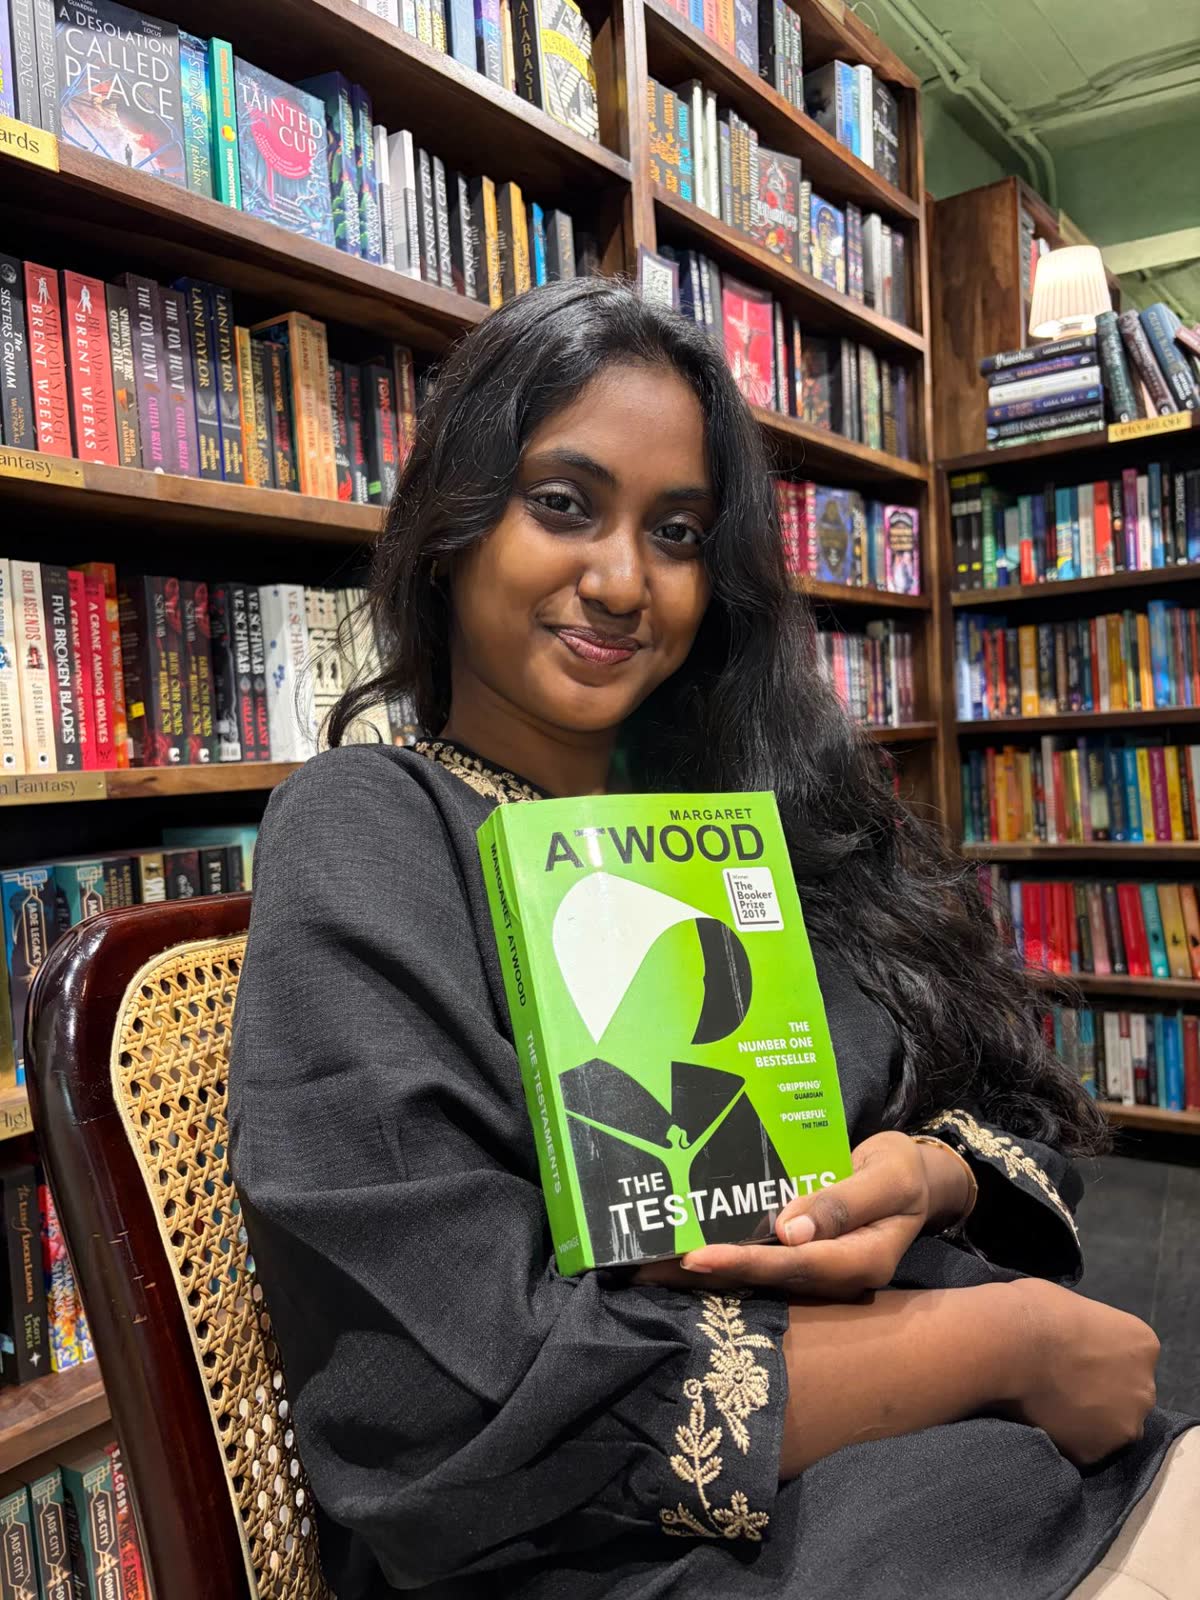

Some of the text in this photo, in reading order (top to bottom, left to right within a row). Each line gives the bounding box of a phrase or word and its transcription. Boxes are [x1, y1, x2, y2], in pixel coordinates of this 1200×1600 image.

[59, 5, 71, 21] A
[75, 10, 173, 57] DESOLATION
[65, 27, 169, 83] CALLED
[143, 27, 162, 38] LOCUS
[518, 1, 535, 104] ATABASI
[65, 54, 174, 121] PEACE
[188, 57, 201, 112] STONE
[192, 113, 205, 145] SKY
[238, 81, 324, 140] TAINTED
[190, 143, 202, 186] JEMISIN
[278, 125, 318, 157] CUP
[420, 161, 437, 267] RED RISING
[434, 168, 452, 272] RED RISING
[462, 221, 476, 283] RISING
[0, 288, 17, 389] SISTERS GRIMM
[13, 331, 23, 353] The
[109, 309, 119, 332] OUT
[111, 333, 119, 346] OF
[118, 306, 135, 383] SPARKING FIRE
[136, 286, 159, 382] THE FOX HUNT
[191, 287, 210, 388] LAINI TAYLOR
[215, 294, 234, 393] LAINI TAYLOR
[164, 299, 186, 393] THE FOX HUNT
[30, 303, 54, 445] BRENT WEEKS
[74, 312, 97, 450] BRENT WEEKS
[331, 406, 341, 449] HAVEN
[377, 376, 395, 465] TORCHFIRE
[0, 454, 54, 478] antasy
[23, 595, 41, 641] ASCENDS
[233, 610, 251, 675] SCHWAB
[250, 611, 266, 676] SCHWAB
[51, 594, 76, 744] FIVE BROKEN BLADES
[88, 601, 109, 744] A CRANE AMONG WOLVES
[15, 779, 78, 797] Fantasy
[669, 807, 753, 821] MARGARET
[544, 823, 765, 873] ATWOOD
[207, 861, 222, 895] FUR
[734, 881, 753, 891] The
[737, 890, 773, 900] Booker
[489, 842, 527, 1008] MARGARET ATWOOD
[739, 900, 765, 910] Prize
[741, 909, 767, 920] 2019
[26, 902, 42, 967] JADE LEGACY
[737, 1036, 814, 1054] NUMBER ONE
[787, 1020, 811, 1034] THE
[754, 1052, 817, 1069] BESTSELLER
[525, 1029, 563, 1196] THE TESTAMENTS
[794, 1091, 824, 1101] GUARDIAN
[801, 1120, 829, 1130] THE TIMES
[617, 1171, 667, 1198] THE
[24, 1313, 34, 1349] LYNCH
[31, 1315, 41, 1345] SCOTT
[44, 1510, 61, 1559] JADE CITY
[95, 1499, 110, 1546] JADE CITY
[9, 1531, 26, 1579] JADE CITY
